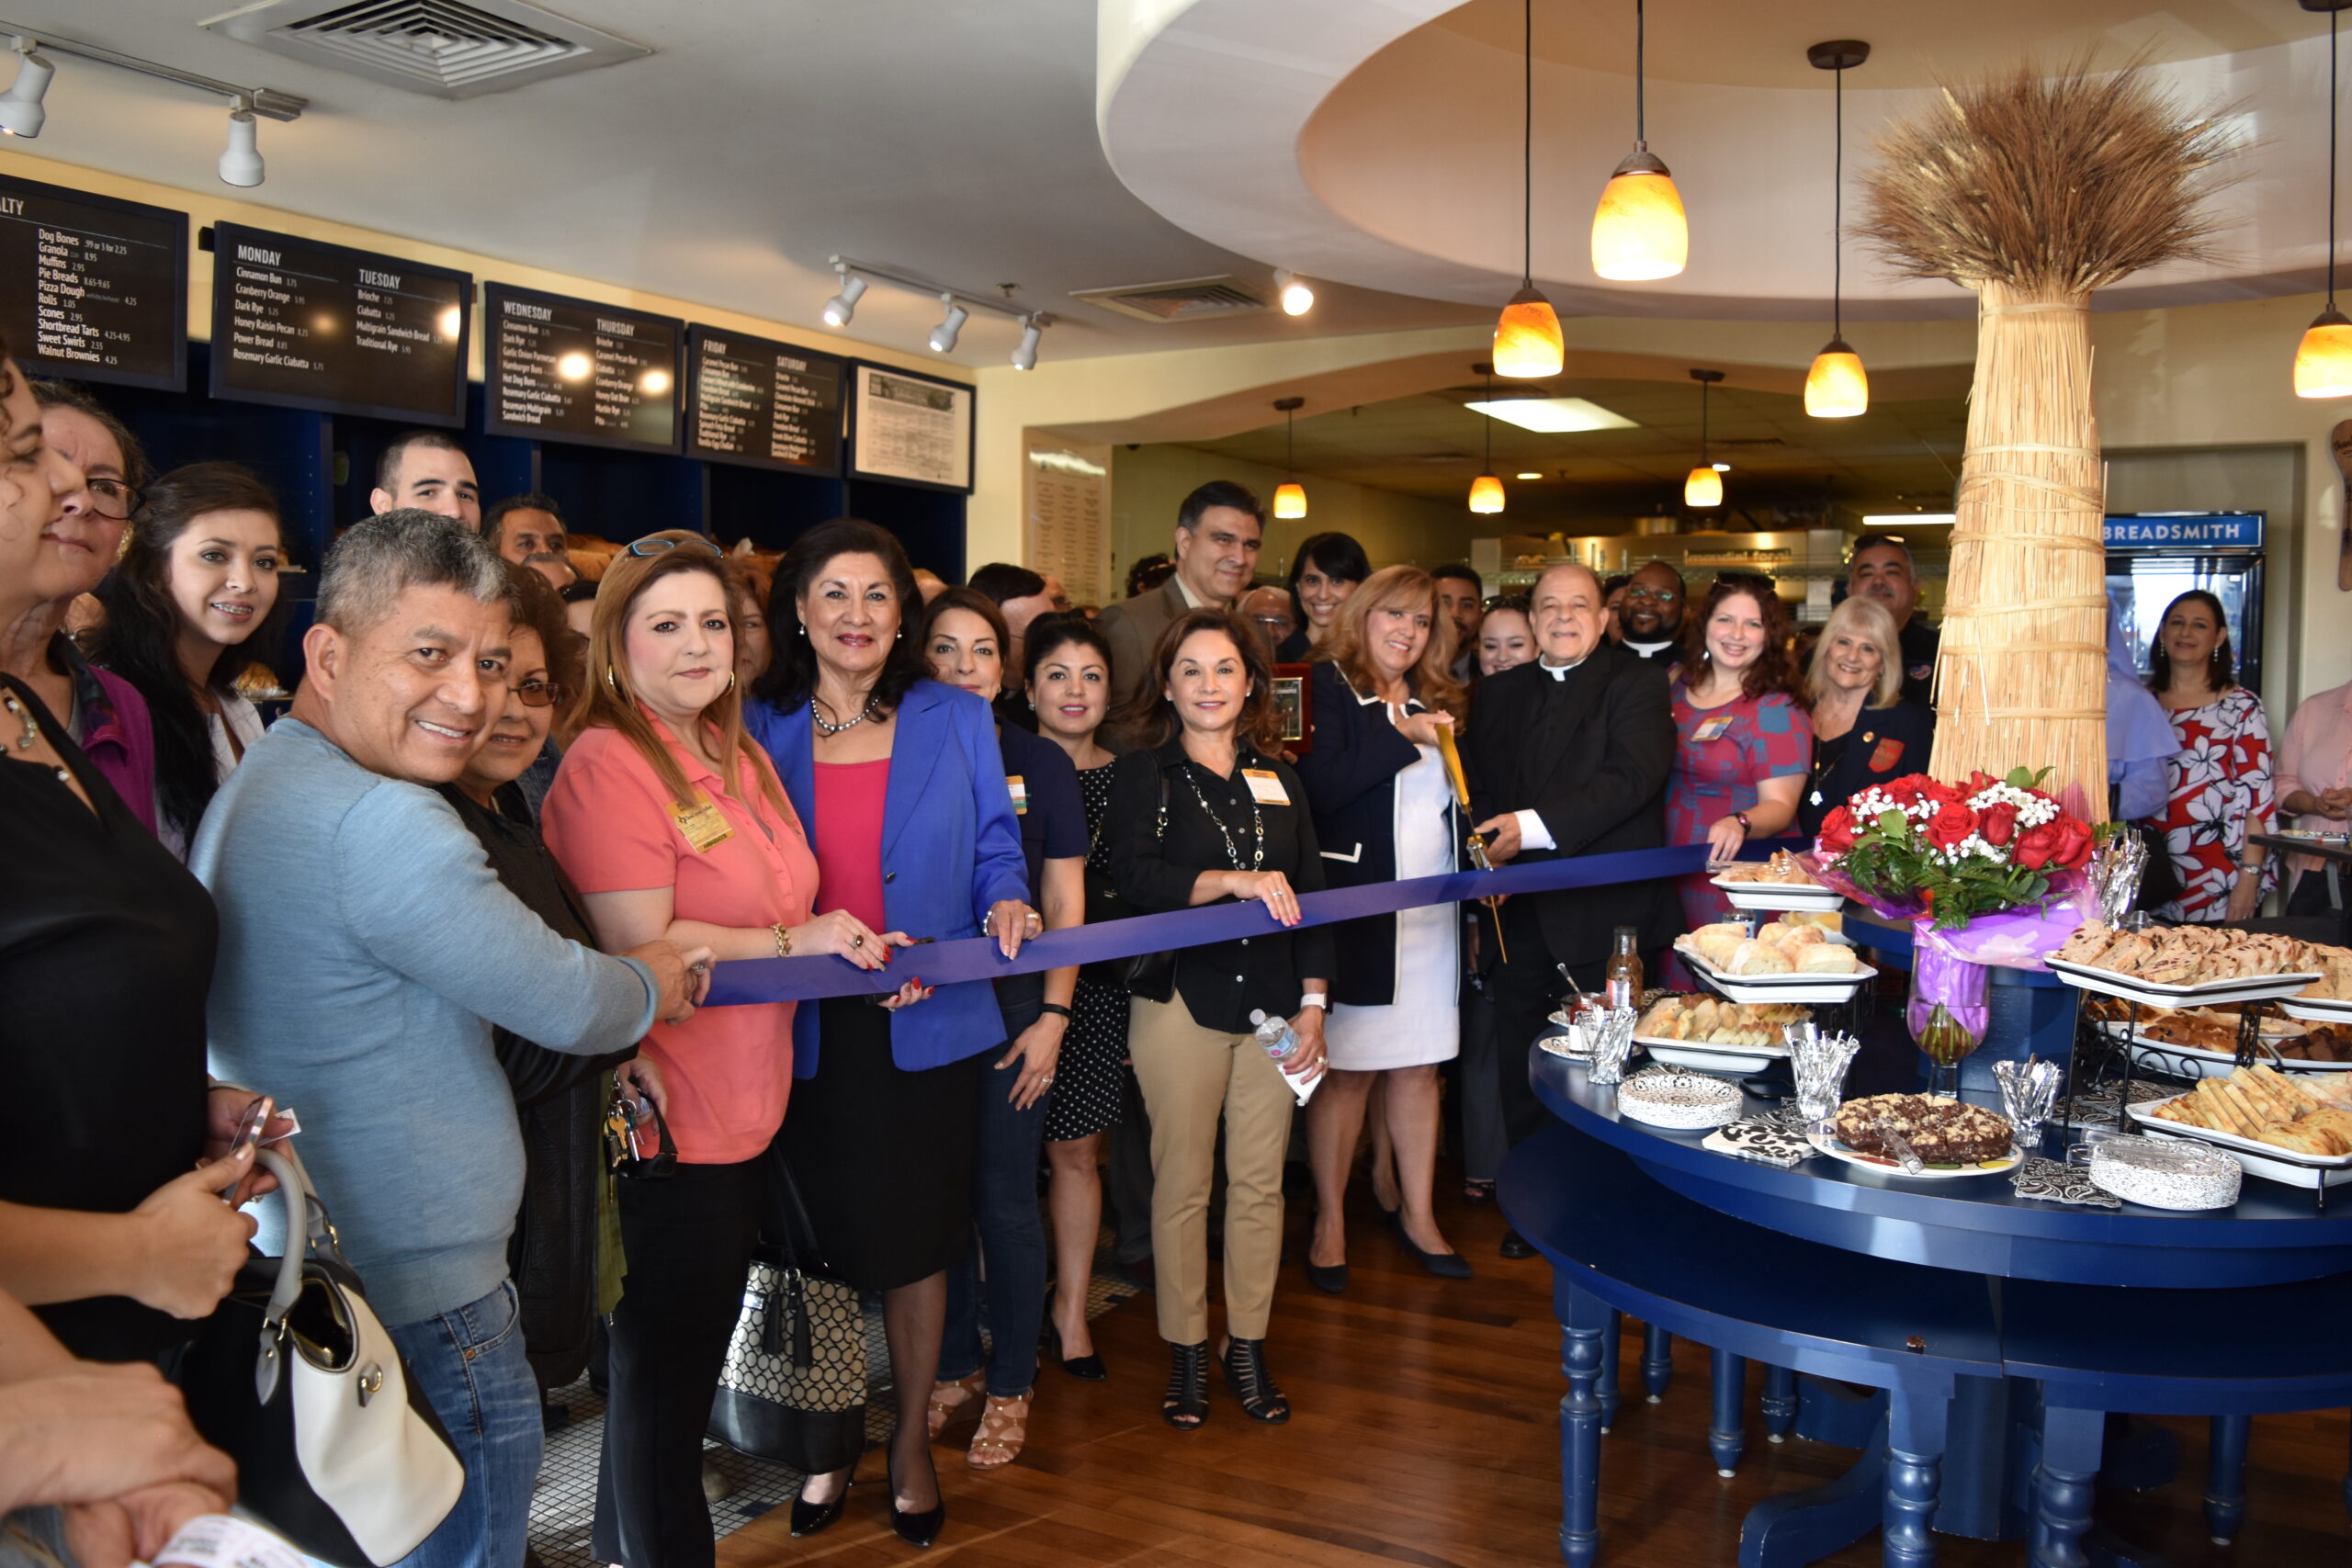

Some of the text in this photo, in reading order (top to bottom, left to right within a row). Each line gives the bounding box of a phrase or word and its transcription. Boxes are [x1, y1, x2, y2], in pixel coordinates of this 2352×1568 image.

[0, 196, 24, 215] LTY
[39, 229, 54, 243] Dog
[56, 231, 79, 246] Bones
[39, 242, 68, 256] Granola
[238, 244, 281, 266] MONDAY
[39, 254, 66, 269] Muffins
[39, 266, 51, 279] Pie
[52, 269, 79, 284] Breads
[236, 266, 268, 282] Cinnamon
[269, 273, 282, 285] Bun
[358, 268, 401, 289] TUESDAY
[39, 279, 59, 293] Pizza
[60, 283, 85, 299] Dough
[236, 283, 267, 300] Cranberry
[267, 288, 290, 304] Orange
[39, 292, 58, 306] Rolls
[235, 299, 251, 311] Dark
[251, 301, 264, 315] Rye
[38, 305, 65, 320] Scones
[503, 300, 552, 321] WEDNESDAY
[38, 318, 80, 334] Shortbread
[81, 324, 99, 337] Tarts
[234, 315, 255, 331] Honey
[255, 319, 276, 332] Raisin
[276, 321, 295, 334] Pecan
[596, 318, 635, 337] THURSDAY
[38, 331, 62, 344] Sweet
[62, 334, 85, 348] Swirls
[233, 332, 254, 344] Power
[254, 334, 274, 348] Bread
[413, 329, 430, 342] Bread
[38, 344, 64, 358] Walnut
[65, 347, 101, 363] Brownies
[233, 348, 265, 365] Rosemary
[265, 353, 282, 366] Garlic
[283, 355, 310, 369] Ciabatta
[2103, 525, 2240, 540] BREADSMITH
